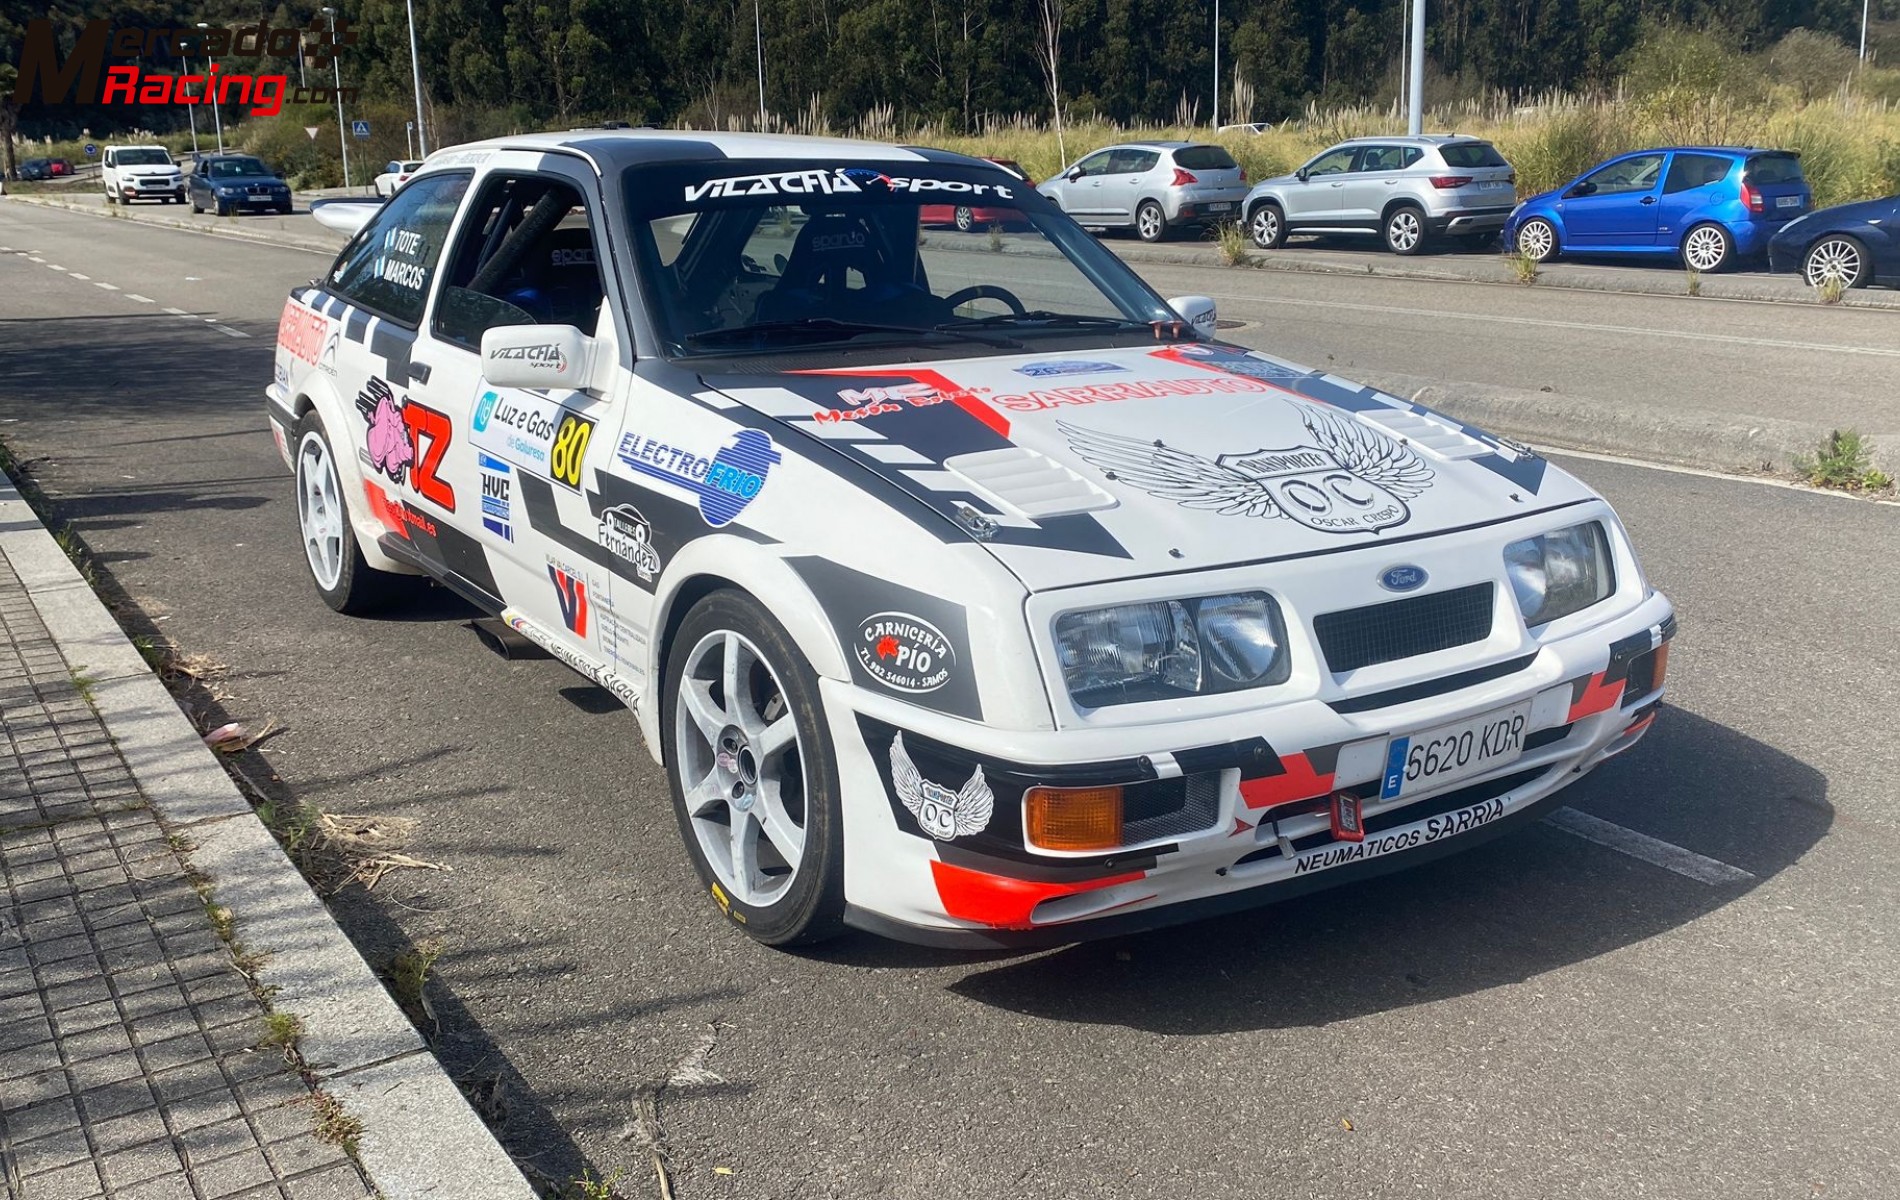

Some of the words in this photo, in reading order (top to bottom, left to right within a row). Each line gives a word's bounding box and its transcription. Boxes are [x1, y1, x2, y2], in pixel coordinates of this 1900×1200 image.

[887, 177, 1014, 199] sport
[395, 229, 421, 255] TOTE
[552, 248, 594, 266] spar
[384, 259, 425, 290] MARCOS
[991, 377, 1267, 412] SARRIAUTO
[494, 397, 518, 426] Luz
[516, 411, 527, 430] e
[526, 409, 554, 441] Gas
[552, 415, 590, 486] 80
[480, 472, 510, 502] HVC
[1281, 473, 1376, 516] OC
[613, 517, 636, 536] TALLERES
[1310, 516, 1360, 528] OSCAR
[1362, 504, 1400, 524] CRESPO
[598, 523, 655, 572] Fernández
[1391, 569, 1417, 585] Ford
[864, 621, 947, 659] CARNICERÍA
[895, 643, 931, 673] PÍO
[869, 661, 886, 677] 982
[886, 671, 916, 688] 546014
[921, 667, 948, 687] SAMOS
[1406, 730, 1474, 782] 6620
[1478, 714, 1525, 761] KDR
[1387, 775, 1398, 789] E
[925, 803, 952, 828] OC
[1294, 830, 1420, 874] NEUMATICOS
[1425, 798, 1504, 842] SARRIA
